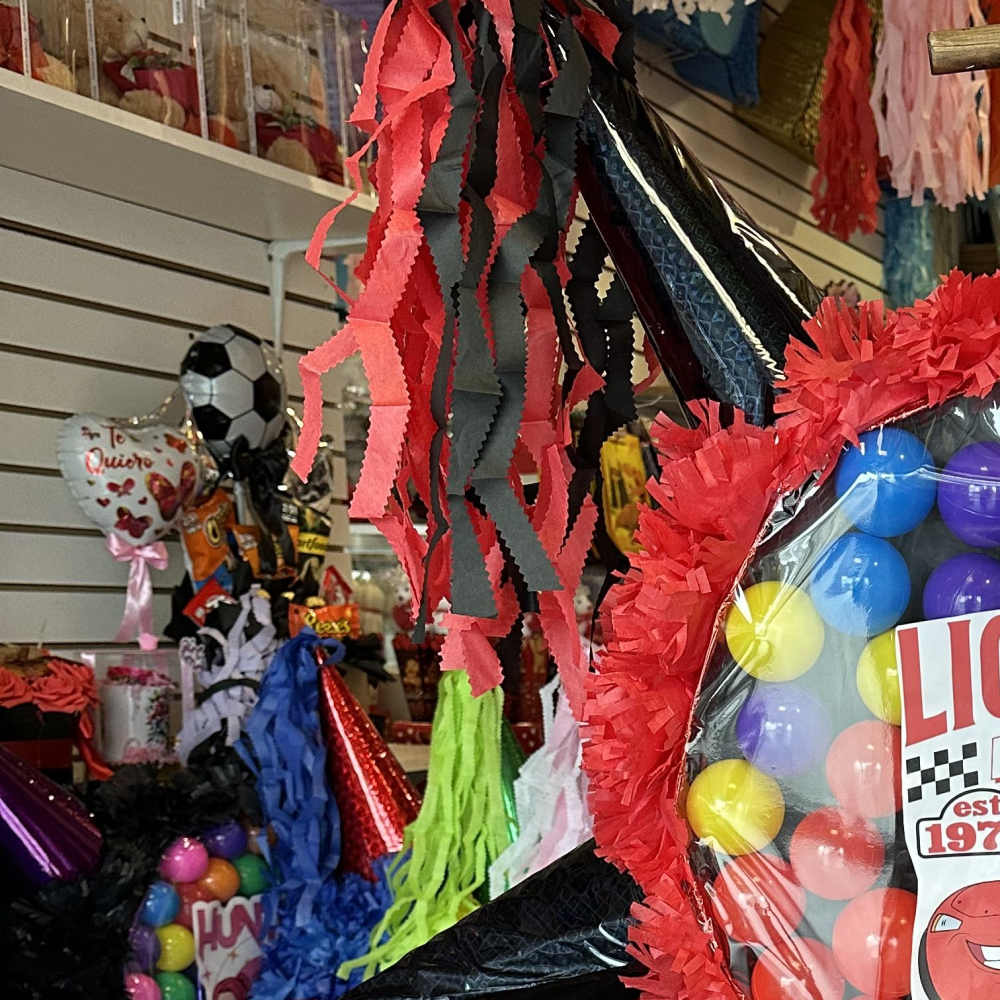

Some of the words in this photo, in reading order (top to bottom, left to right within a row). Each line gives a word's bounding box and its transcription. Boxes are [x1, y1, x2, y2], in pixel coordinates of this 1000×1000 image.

[101, 425, 126, 449] Te
[85, 447, 154, 475] Quiero
[196, 902, 264, 966] HUN
